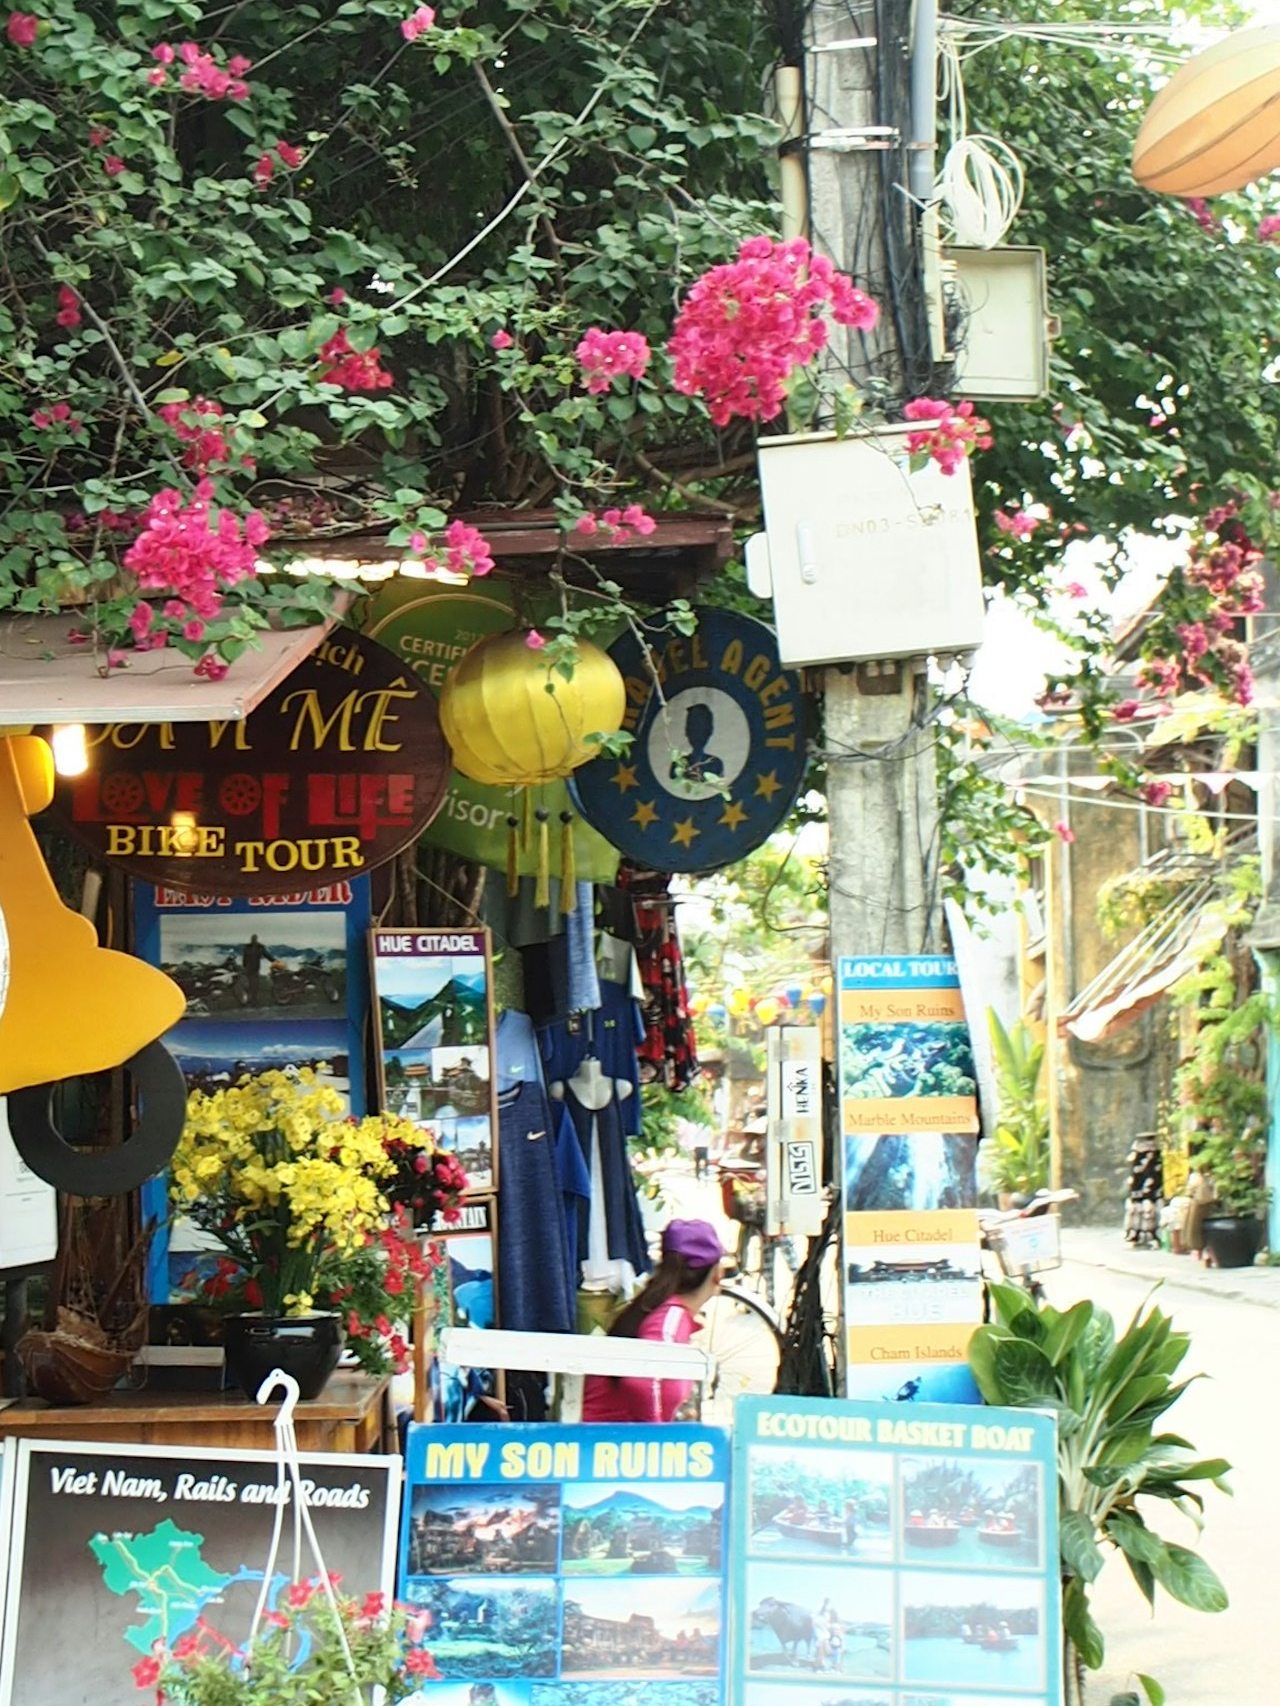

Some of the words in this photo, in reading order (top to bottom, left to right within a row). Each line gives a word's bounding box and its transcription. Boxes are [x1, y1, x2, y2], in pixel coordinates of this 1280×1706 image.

[280, 676, 418, 752] MÊ
[721, 638, 796, 752] AGENT
[73, 772, 205, 822] LOVE
[220, 772, 289, 840] OF
[308, 774, 415, 840] LIFE
[105, 825, 225, 857] BIKE
[235, 835, 364, 873] TOUR
[378, 935, 412, 952] HUE
[416, 934, 480, 952] CITADEL
[844, 961, 907, 978] LOCAL
[859, 1004, 882, 1021] My
[886, 1003, 912, 1018] Son
[915, 1004, 955, 1018] Ruins
[848, 1112, 896, 1127] Marble
[901, 1111, 971, 1126] Mountains
[873, 1229, 901, 1243] Hue
[905, 1229, 953, 1242] Citadel
[870, 1346, 913, 1361] Cham
[915, 1345, 963, 1359] Islands
[756, 1411, 873, 1442] ECOTOUR
[876, 1419, 967, 1447] BASKET
[970, 1424, 1035, 1452] BOAT
[425, 1442, 490, 1479] MY
[500, 1441, 580, 1479] SON
[592, 1441, 715, 1479] RUINS
[50, 1467, 98, 1495] Viet
[101, 1470, 168, 1503] Nam,
[174, 1473, 238, 1503] Rails
[240, 1480, 293, 1505] and
[296, 1480, 370, 1509] Roads
